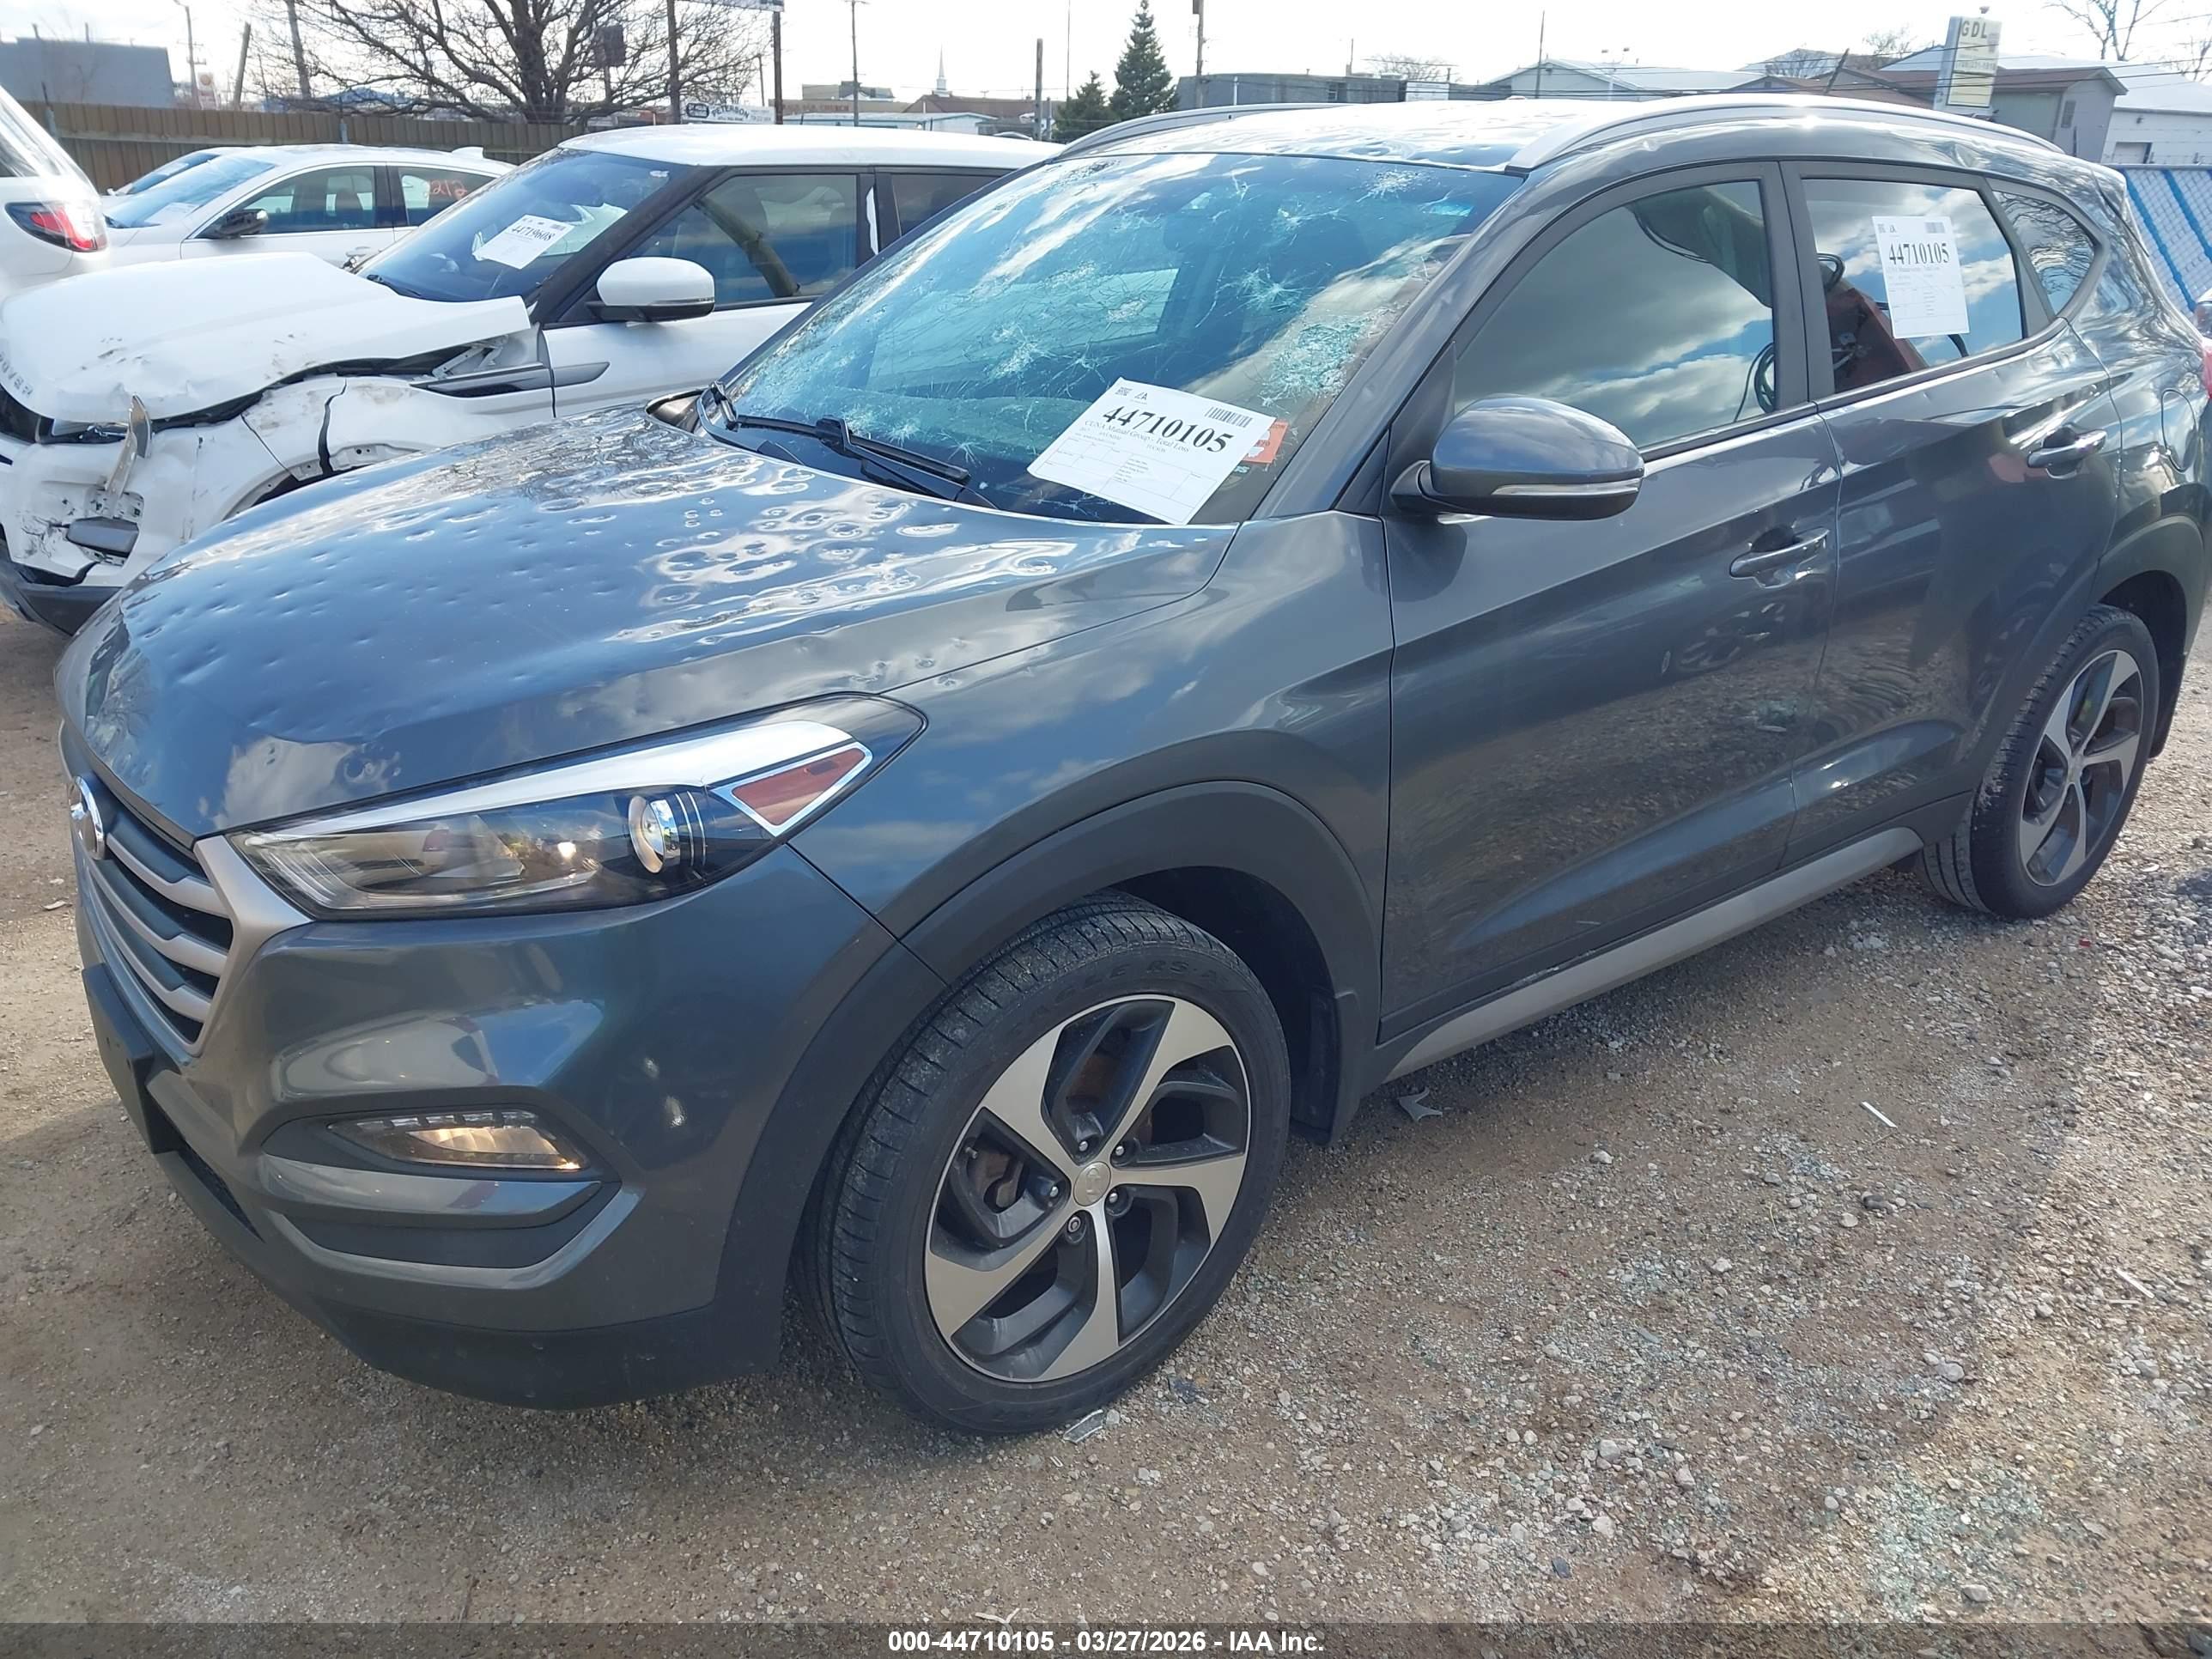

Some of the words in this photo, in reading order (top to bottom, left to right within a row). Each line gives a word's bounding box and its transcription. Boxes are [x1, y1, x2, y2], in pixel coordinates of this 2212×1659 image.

[1961, 20, 1988, 39] GDL
[711, 105, 750, 118] PETERSON
[1888, 242, 1950, 265] 44710105
[1103, 405, 1235, 453] 44710105
